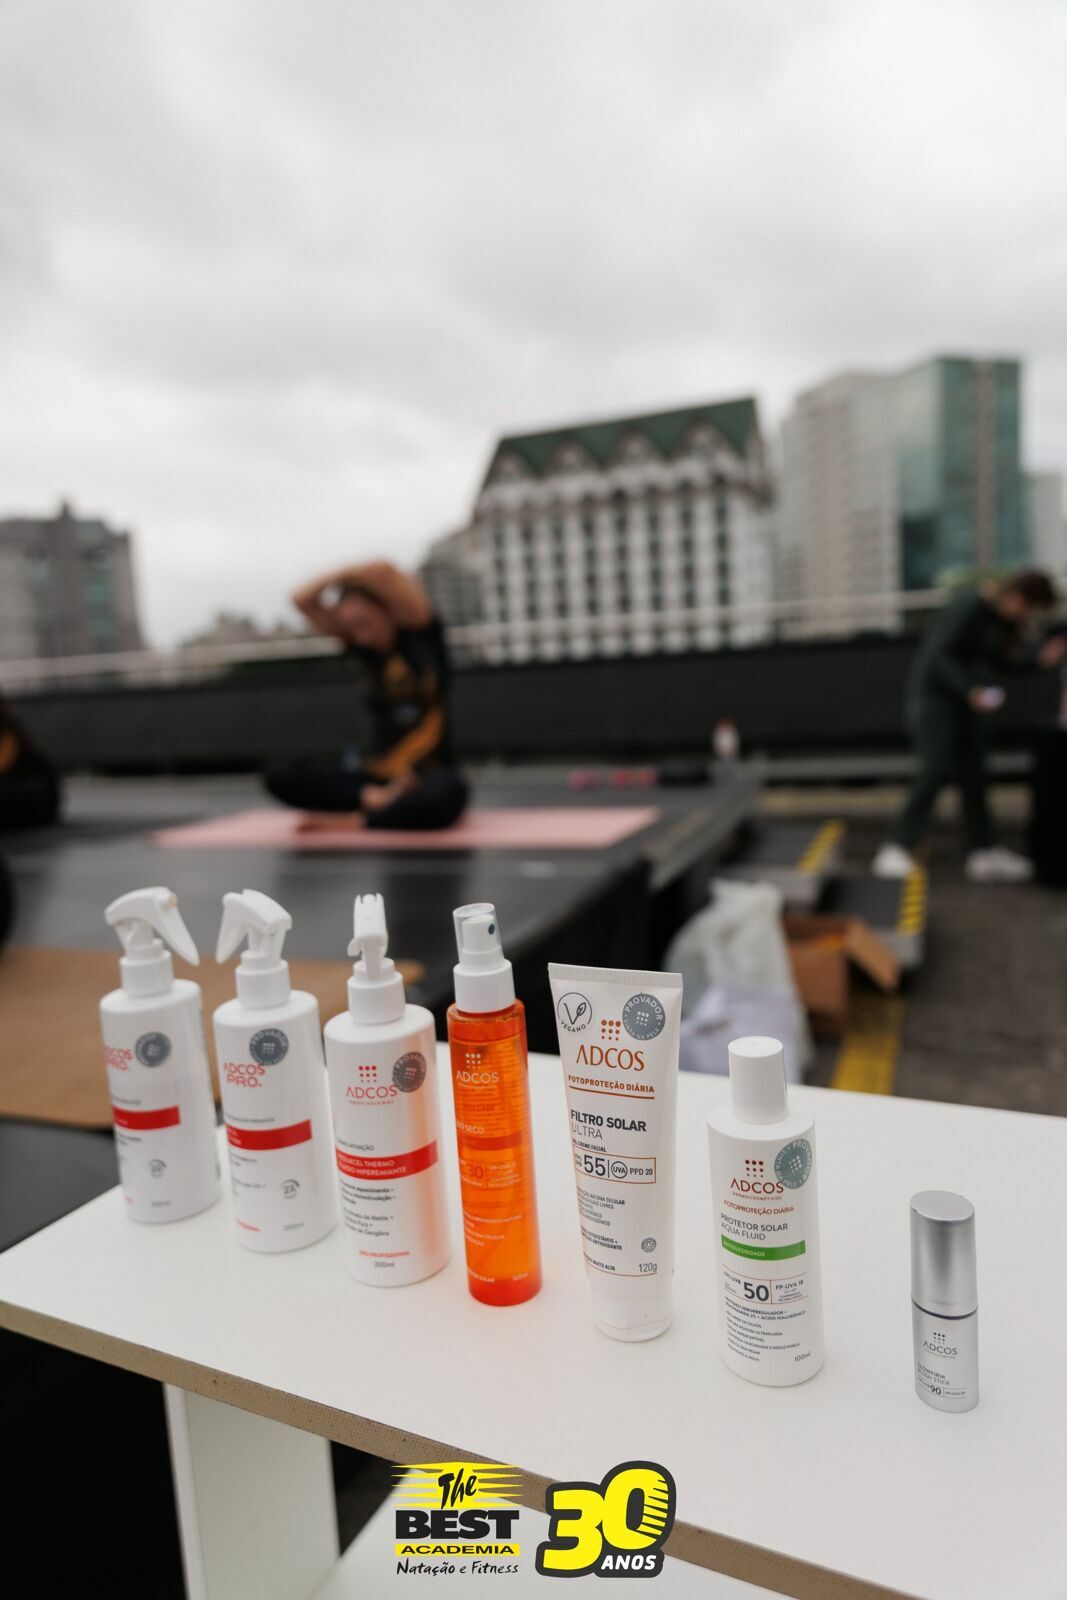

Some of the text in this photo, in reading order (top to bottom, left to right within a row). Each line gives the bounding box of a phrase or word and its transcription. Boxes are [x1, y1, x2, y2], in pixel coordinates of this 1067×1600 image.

[624, 996, 663, 1020] PROVADOR
[560, 1021, 586, 1033] VEGANO
[576, 1044, 645, 1072] ADCOS
[224, 1062, 266, 1076] ADCOS
[456, 1071, 499, 1084] ADCOS
[346, 1085, 398, 1099] ADCOS
[568, 1074, 655, 1093] FOTOPROTEÇÃO DIÁRIA
[570, 1109, 647, 1132] FILTRO SOLAR
[571, 1121, 603, 1139] ULTRA
[591, 1144, 607, 1152] FACIAL
[583, 1154, 606, 1176] 55
[612, 1166, 626, 1174] UVA
[645, 1168, 653, 1176] 20
[730, 1178, 784, 1194] ADCOS
[723, 1199, 795, 1216] FOTOPROTEÇÃO DIÁRIA
[721, 1213, 789, 1232] PROTETOR SOLAR
[721, 1221, 766, 1241] AQUA FLUID
[638, 1262, 658, 1273] 120g
[743, 1281, 770, 1302] 50
[923, 1341, 958, 1355] ADCOS
[930, 1384, 942, 1395] 90
